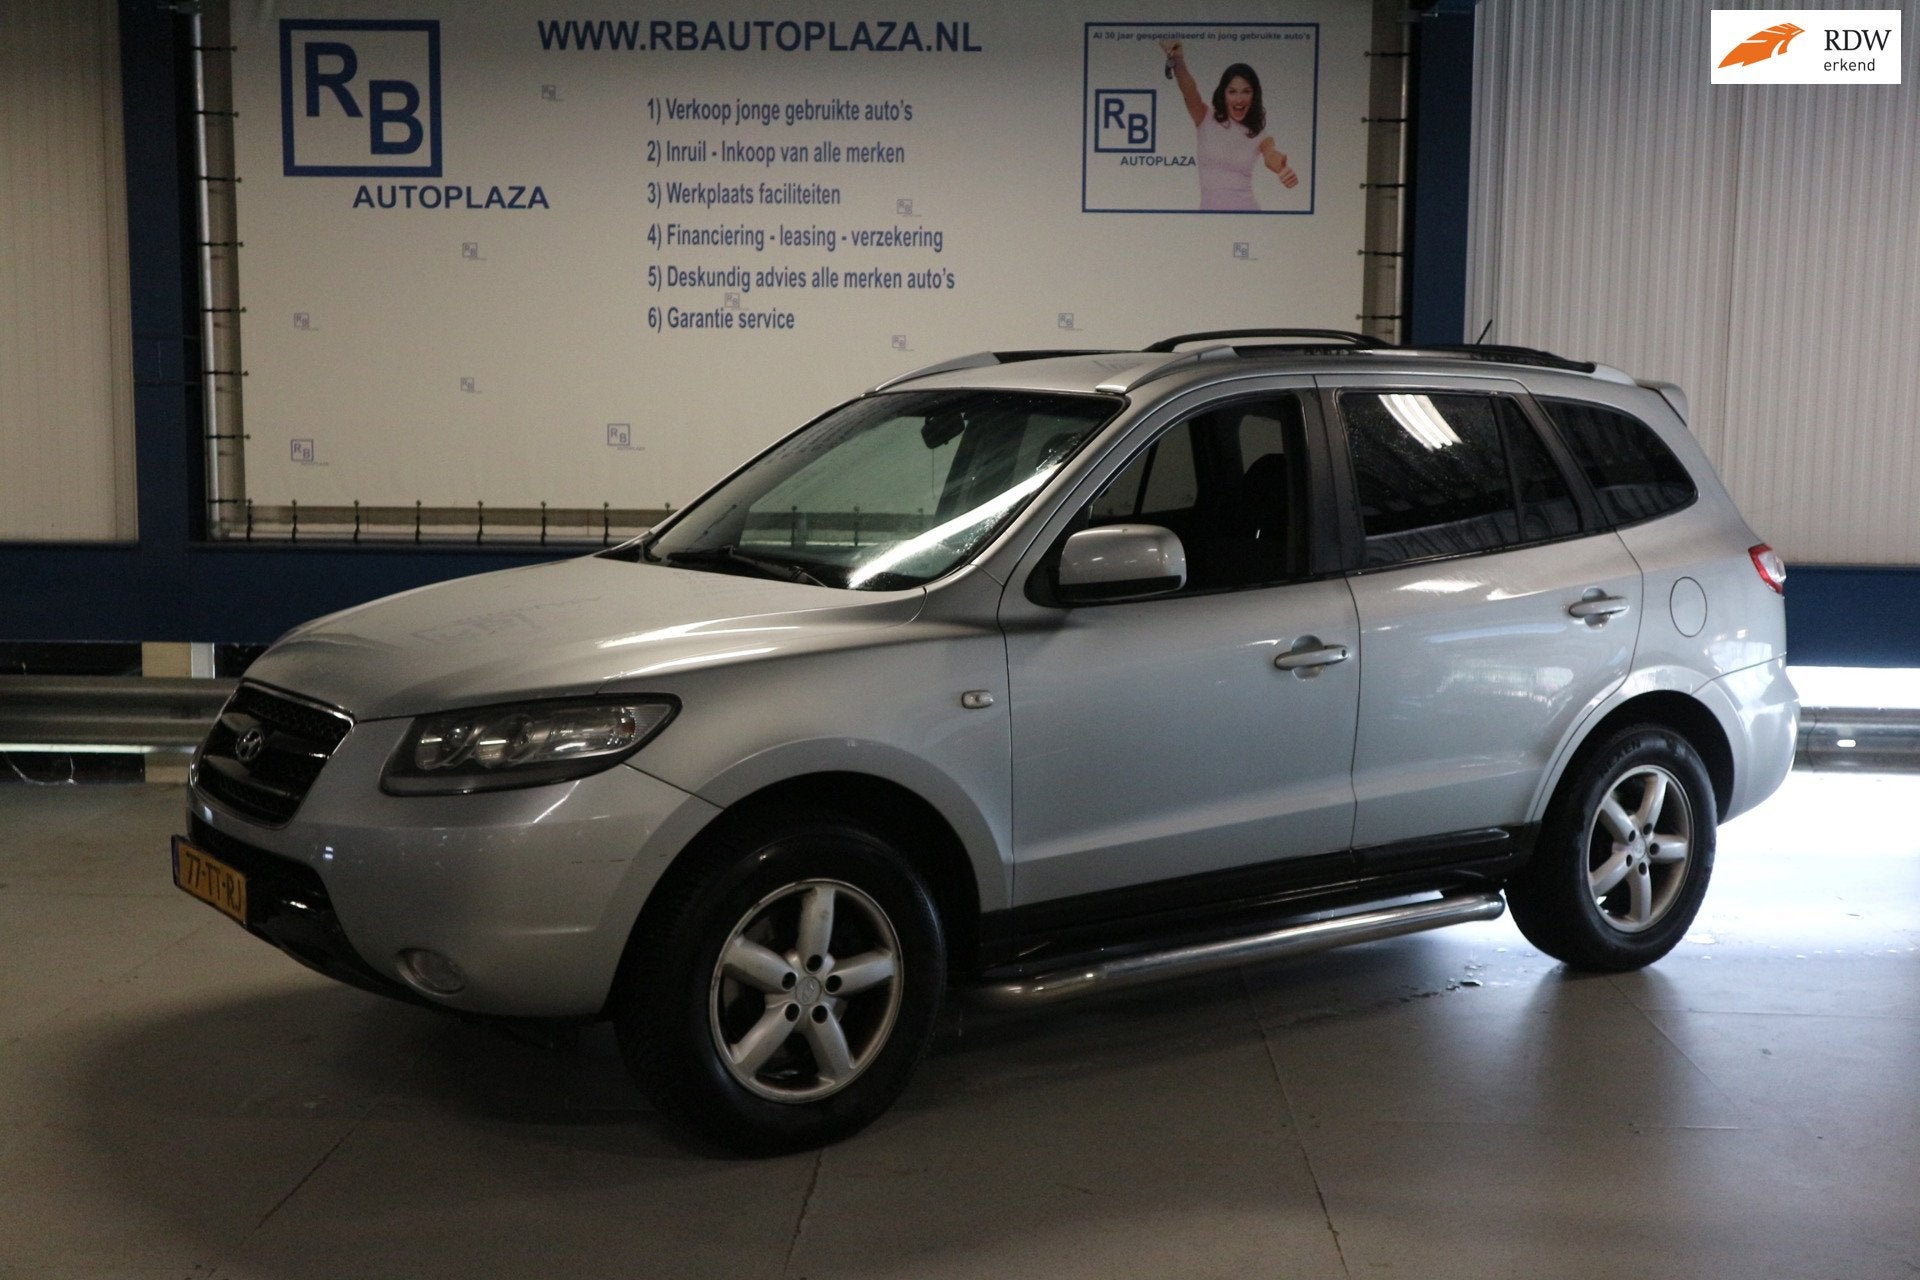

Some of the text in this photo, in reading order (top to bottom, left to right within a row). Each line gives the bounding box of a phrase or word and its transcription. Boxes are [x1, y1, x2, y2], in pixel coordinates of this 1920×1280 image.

[537, 20, 982, 52] WWW.RBAUTOPLAZA.NL
[1105, 31, 1116, 39] 30
[1117, 31, 1134, 41] jaar
[1217, 32, 1238, 41] jong
[1240, 32, 1282, 42] gebruikte
[1284, 32, 1311, 40] auto's
[304, 41, 424, 155] RB
[647, 98, 913, 126] 1) Verkoop jonge gebruikte auto's
[1104, 98, 1149, 144] RB
[647, 140, 661, 168] 2)
[666, 140, 706, 162] Inruil
[722, 140, 776, 168] Inkoop
[780, 145, 808, 162] van
[814, 141, 841, 163] alle
[846, 141, 905, 163] merken
[1120, 156, 1196, 166] AUTOPLAZA
[352, 185, 550, 210] AUTOPLAZA
[647, 182, 841, 209] 3) Werkplaats faciliteiten
[647, 223, 662, 251] 4)
[667, 223, 765, 252] Financiering
[780, 225, 836, 252] leasing
[851, 226, 944, 253] verzekering
[648, 265, 955, 293] 5) Deskundig advies alle merken auto's
[648, 307, 795, 334] 6) Garantie service
